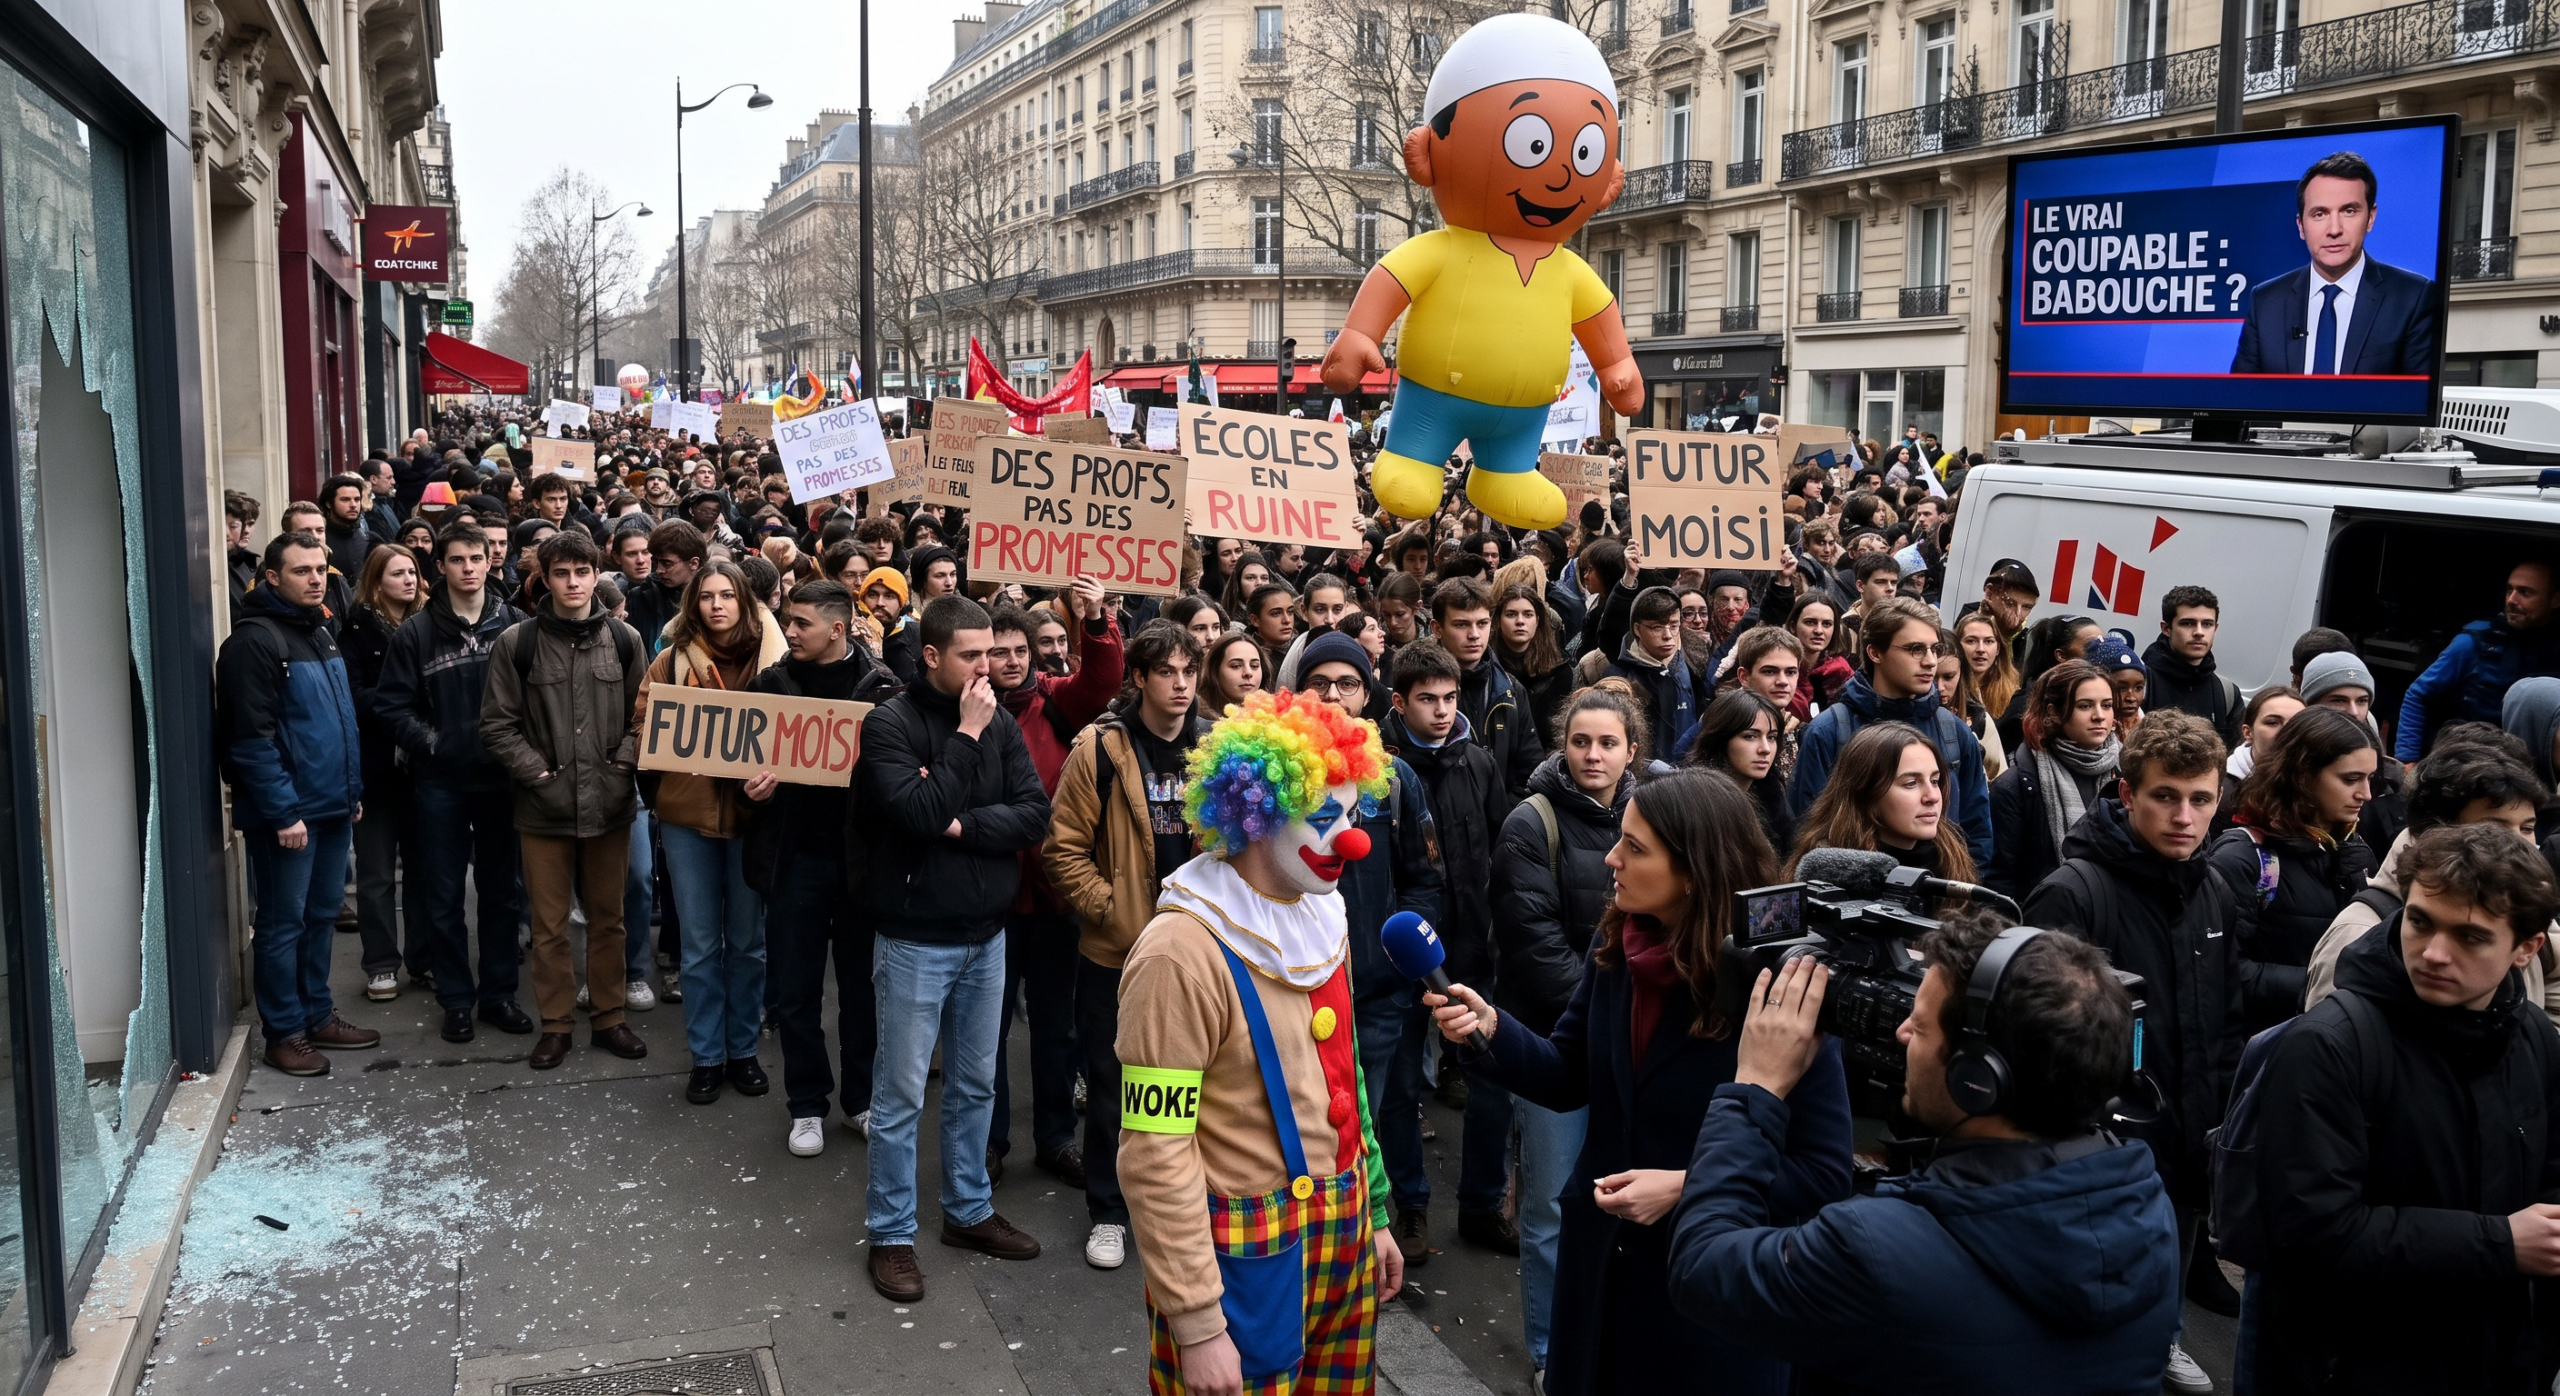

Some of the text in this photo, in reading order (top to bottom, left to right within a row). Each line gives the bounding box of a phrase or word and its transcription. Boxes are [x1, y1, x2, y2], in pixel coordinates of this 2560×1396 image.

[2034, 201, 2123, 233] LE VRAI
[374, 259, 439, 270] COATCHIKE
[2033, 231, 2209, 274] COUPABLE
[2032, 273, 2247, 315] BABOUCHE ?
[781, 421, 812, 444] DES
[818, 406, 875, 434] PROFS,
[1193, 411, 1339, 471] ÉCOLES
[796, 446, 858, 474] PAS DES
[804, 457, 884, 493] PROMESSES
[991, 448, 1176, 509] DES PROFS,
[1252, 466, 1288, 490] EN
[1635, 439, 1770, 486] FUTUR
[1024, 495, 1132, 531] PAS DES
[1207, 489, 1341, 541] RUINE
[974, 521, 1178, 587] PROMESSES
[647, 700, 768, 765] FUTUR
[1124, 1081, 1198, 1119] WOKE
